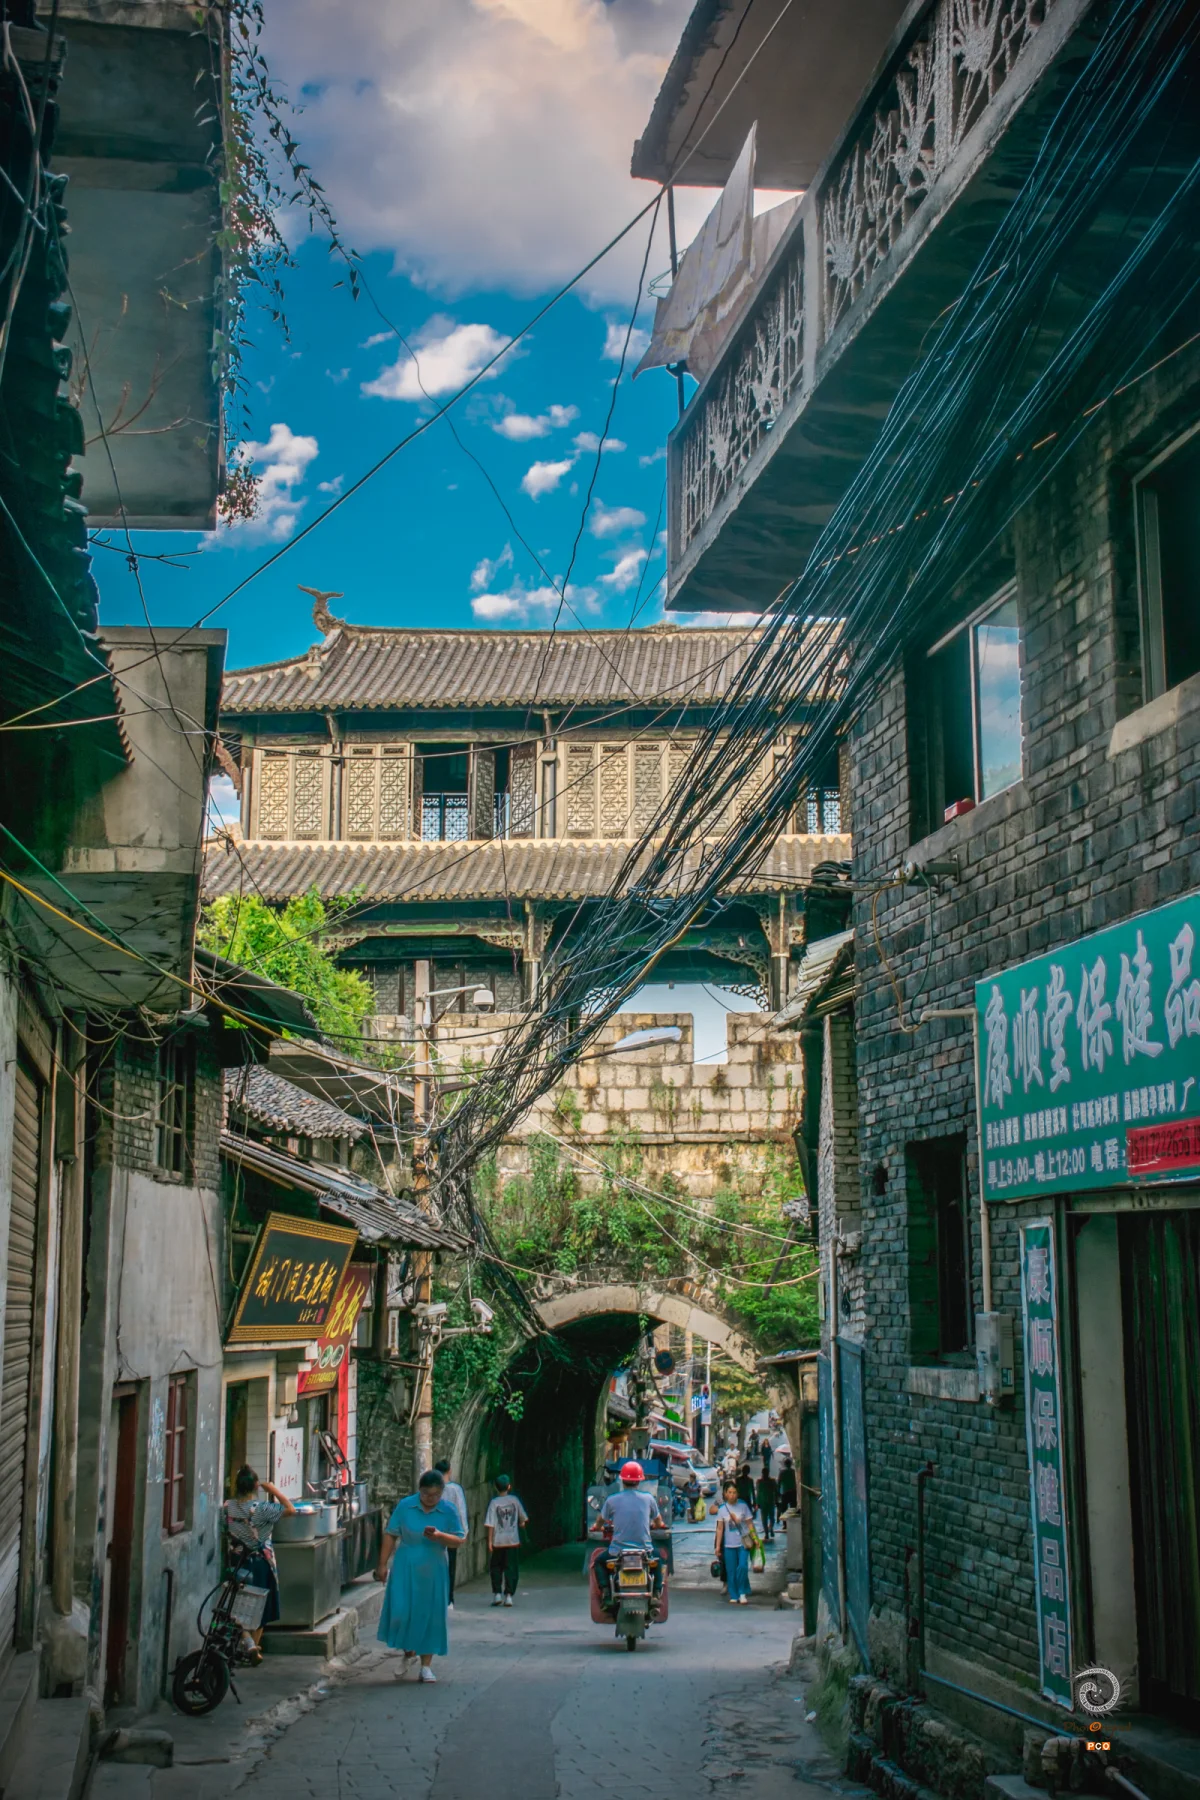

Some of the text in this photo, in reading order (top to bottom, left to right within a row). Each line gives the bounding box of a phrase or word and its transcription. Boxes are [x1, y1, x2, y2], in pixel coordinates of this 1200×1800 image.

[1025, 1245, 1067, 1679] 康顺保健品店
